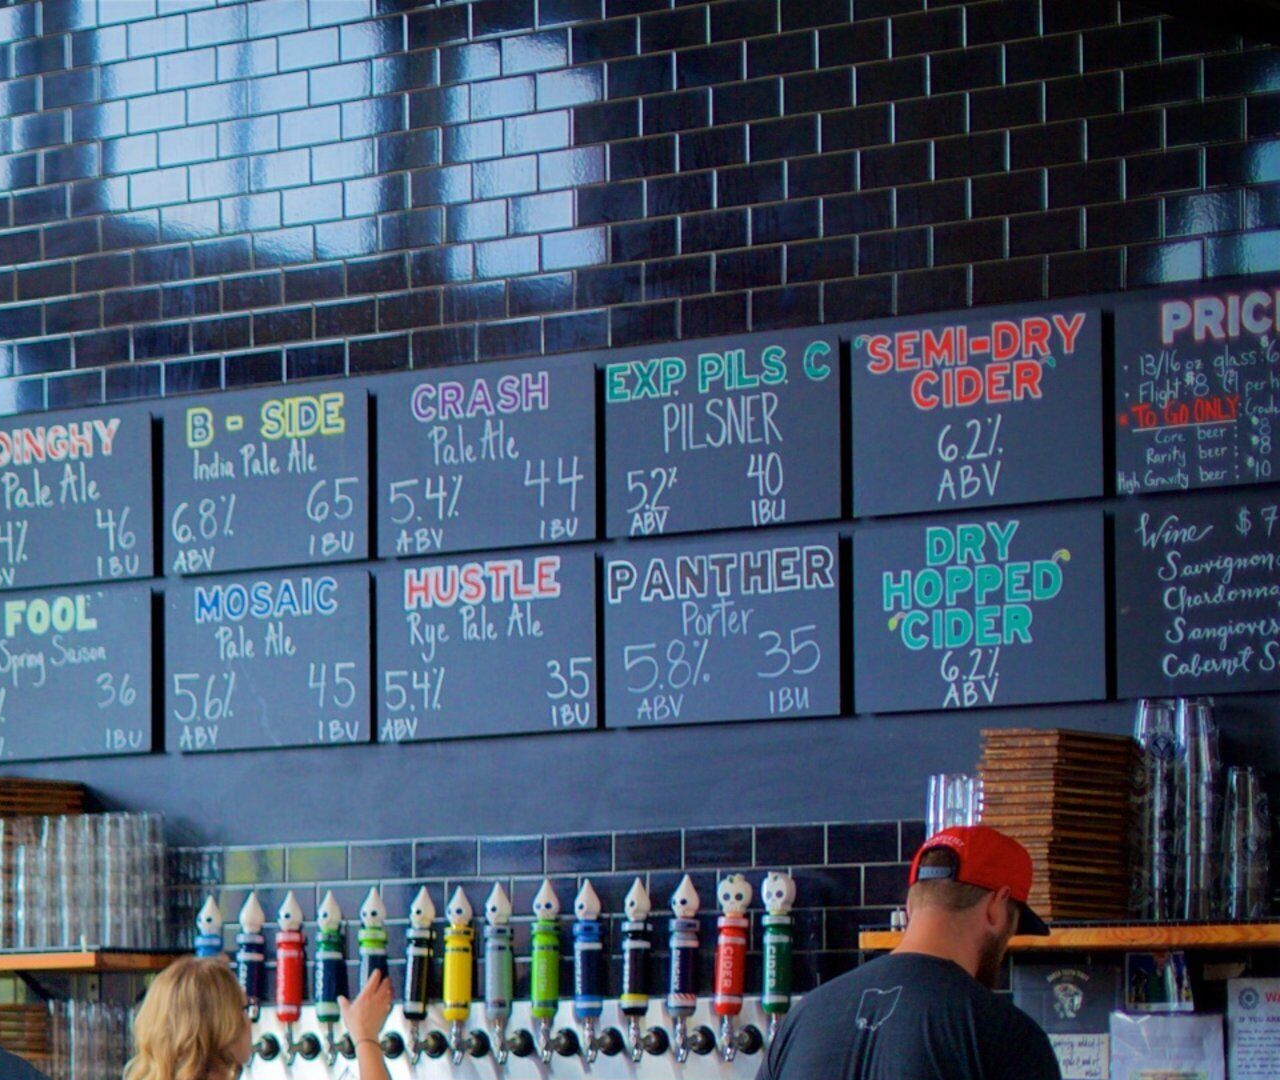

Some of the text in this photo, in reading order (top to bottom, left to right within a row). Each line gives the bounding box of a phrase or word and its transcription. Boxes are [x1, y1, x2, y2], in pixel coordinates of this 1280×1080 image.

[1162, 290, 1280, 344] PRIC
[802, 341, 831, 382] C
[867, 312, 1086, 375] SEMI-DRY
[1139, 349, 1181, 381] 13/16
[1186, 360, 1204, 371] oz
[410, 372, 550, 424] CRASH
[911, 360, 1042, 411] CIDER
[1245, 380, 1267, 398] per
[261, 393, 346, 440] SIDE
[662, 391, 784, 454] PILSNER
[1164, 400, 1190, 425] GO
[428, 419, 519, 467] Pale Ale
[938, 413, 1004, 463] 6.2%
[1146, 447, 1186, 468] Rarity
[1155, 429, 1186, 445] Core
[192, 438, 318, 482] India Pale Ale
[938, 460, 1002, 503] ABV
[1144, 468, 1190, 489] Gravity
[1, 462, 101, 511] Pale Ale
[389, 455, 584, 525] 5.4% 44
[627, 451, 784, 514] 5.2% 40
[96, 506, 136, 553] 46
[171, 477, 359, 543] 6.8% 65
[629, 498, 786, 537] ABV IBU
[1135, 512, 1214, 549] Wine
[173, 530, 355, 573] ABV IBU
[396, 517, 579, 555] ABV IBU
[925, 520, 1020, 566] DRY
[97, 554, 140, 578] IBU
[403, 555, 561, 611] HUSTLE
[606, 545, 836, 604] PANTHER
[883, 560, 1064, 612] HOPPED
[4, 596, 98, 638] FOOL
[194, 576, 339, 625] MOSAIC
[682, 598, 755, 638] Porter
[1164, 584, 1280, 613] Chardonna
[214, 621, 296, 662] Pale Ale
[406, 604, 544, 664] Rye Pale Ale
[901, 604, 1033, 651] CIDER
[1165, 615, 1280, 651] Sangioves
[50, 634, 107, 667] Saison
[624, 625, 822, 694] 5.8% 35
[940, 647, 1001, 683] 6.2%
[1162, 645, 1252, 678] Cabernet
[96, 672, 137, 710] 36
[173, 661, 356, 723] 5.6% 45
[384, 656, 593, 712] 5.4% 35
[637, 687, 810, 721] ABV IBU
[943, 680, 999, 708] ABV
[105, 727, 142, 750] IBU
[179, 720, 360, 749] ABV IBU
[380, 702, 591, 743] ABV IBU
[722, 945, 733, 988] CIDER
[766, 944, 776, 988] CIDER
